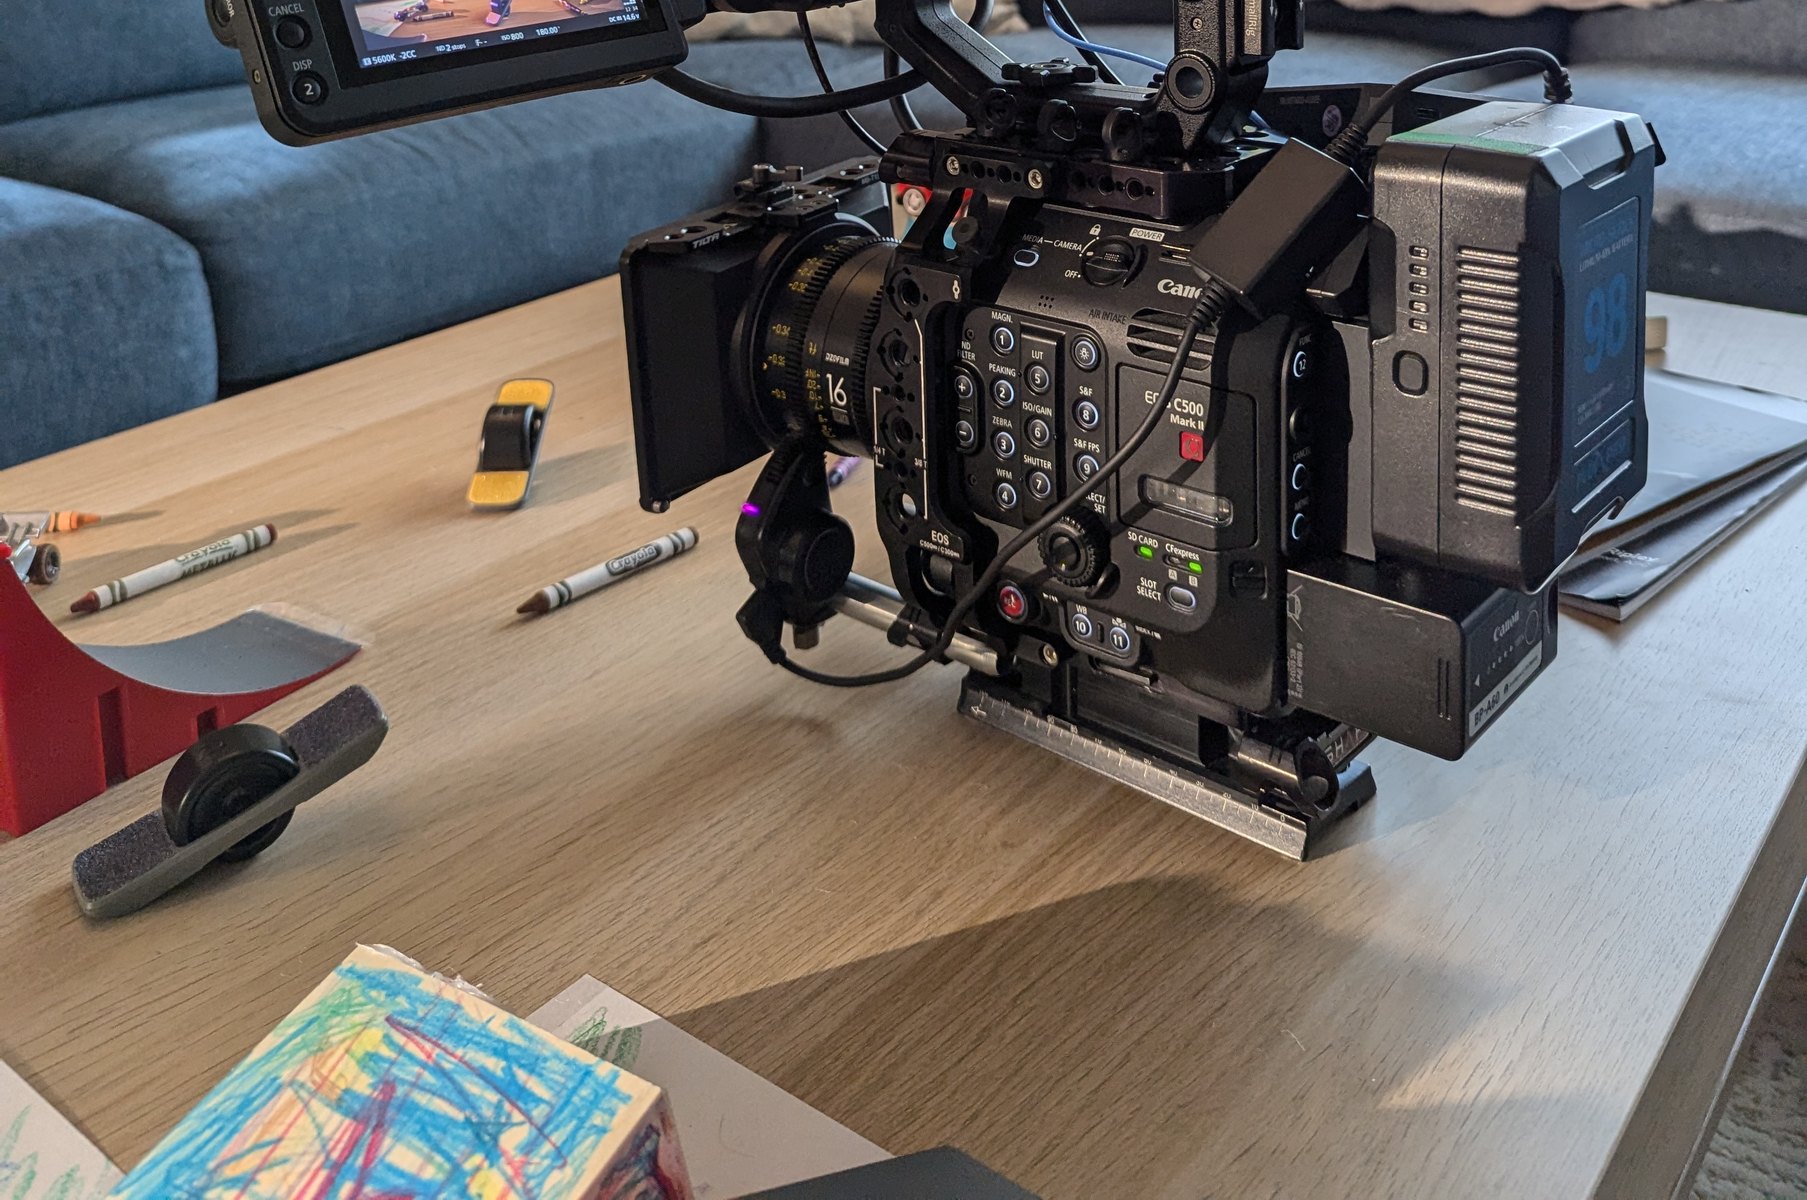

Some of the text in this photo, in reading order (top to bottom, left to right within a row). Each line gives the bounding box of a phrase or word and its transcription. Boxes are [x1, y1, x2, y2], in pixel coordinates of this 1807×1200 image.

[268, 3, 304, 17] CANCEL
[511, 32, 524, 40] 800
[293, 59, 313, 71] DISP
[372, 53, 396, 65] 5600K
[304, 84, 314, 95] 2
[1131, 229, 1162, 240] POWER
[1022, 233, 1082, 251] MEDIA CAMERA
[1064, 269, 1077, 278] OFF
[1157, 279, 1203, 300] Can
[991, 310, 1013, 323] MAGN.
[1088, 309, 1127, 324] AIR INTAKE
[1584, 272, 1628, 374] 98
[961, 341, 971, 350] ND
[1000, 335, 1005, 345] 1
[1031, 350, 1043, 360] LUT
[988, 362, 1016, 377] PEAKING
[1299, 359, 1306, 370] 12
[1034, 373, 1041, 384] 5
[825, 373, 847, 406] 16
[1000, 388, 1006, 398] 2
[1079, 385, 1093, 396] S&F
[1022, 401, 1053, 417] ISO/GAIN
[1173, 397, 1204, 417] C500
[1082, 409, 1090, 421] 8
[1170, 413, 1196, 429] Mark
[992, 416, 1013, 429] ZEBRA
[1034, 427, 1041, 438] 6
[1000, 439, 1007, 451] 3
[1073, 437, 1100, 453] S&F FPS
[1023, 454, 1052, 470] SHUTTER
[1083, 462, 1091, 474] 9
[996, 468, 1012, 480] WFM
[1036, 478, 1042, 490] 7
[1001, 491, 1009, 503] 4
[1094, 503, 1106, 514] SET
[931, 530, 950, 546] EOS
[1128, 531, 1159, 548] SD CARD
[610, 545, 656, 570] Crayola
[1165, 543, 1200, 561] CFexpress
[1140, 577, 1157, 590] SLOT
[1137, 585, 1161, 602] SELECT
[1076, 604, 1088, 614] WB
[1076, 621, 1086, 632] 10
[1493, 610, 1519, 642] Canon
[1113, 634, 1123, 647] 11
[1280, 814, 1285, 823] 0
